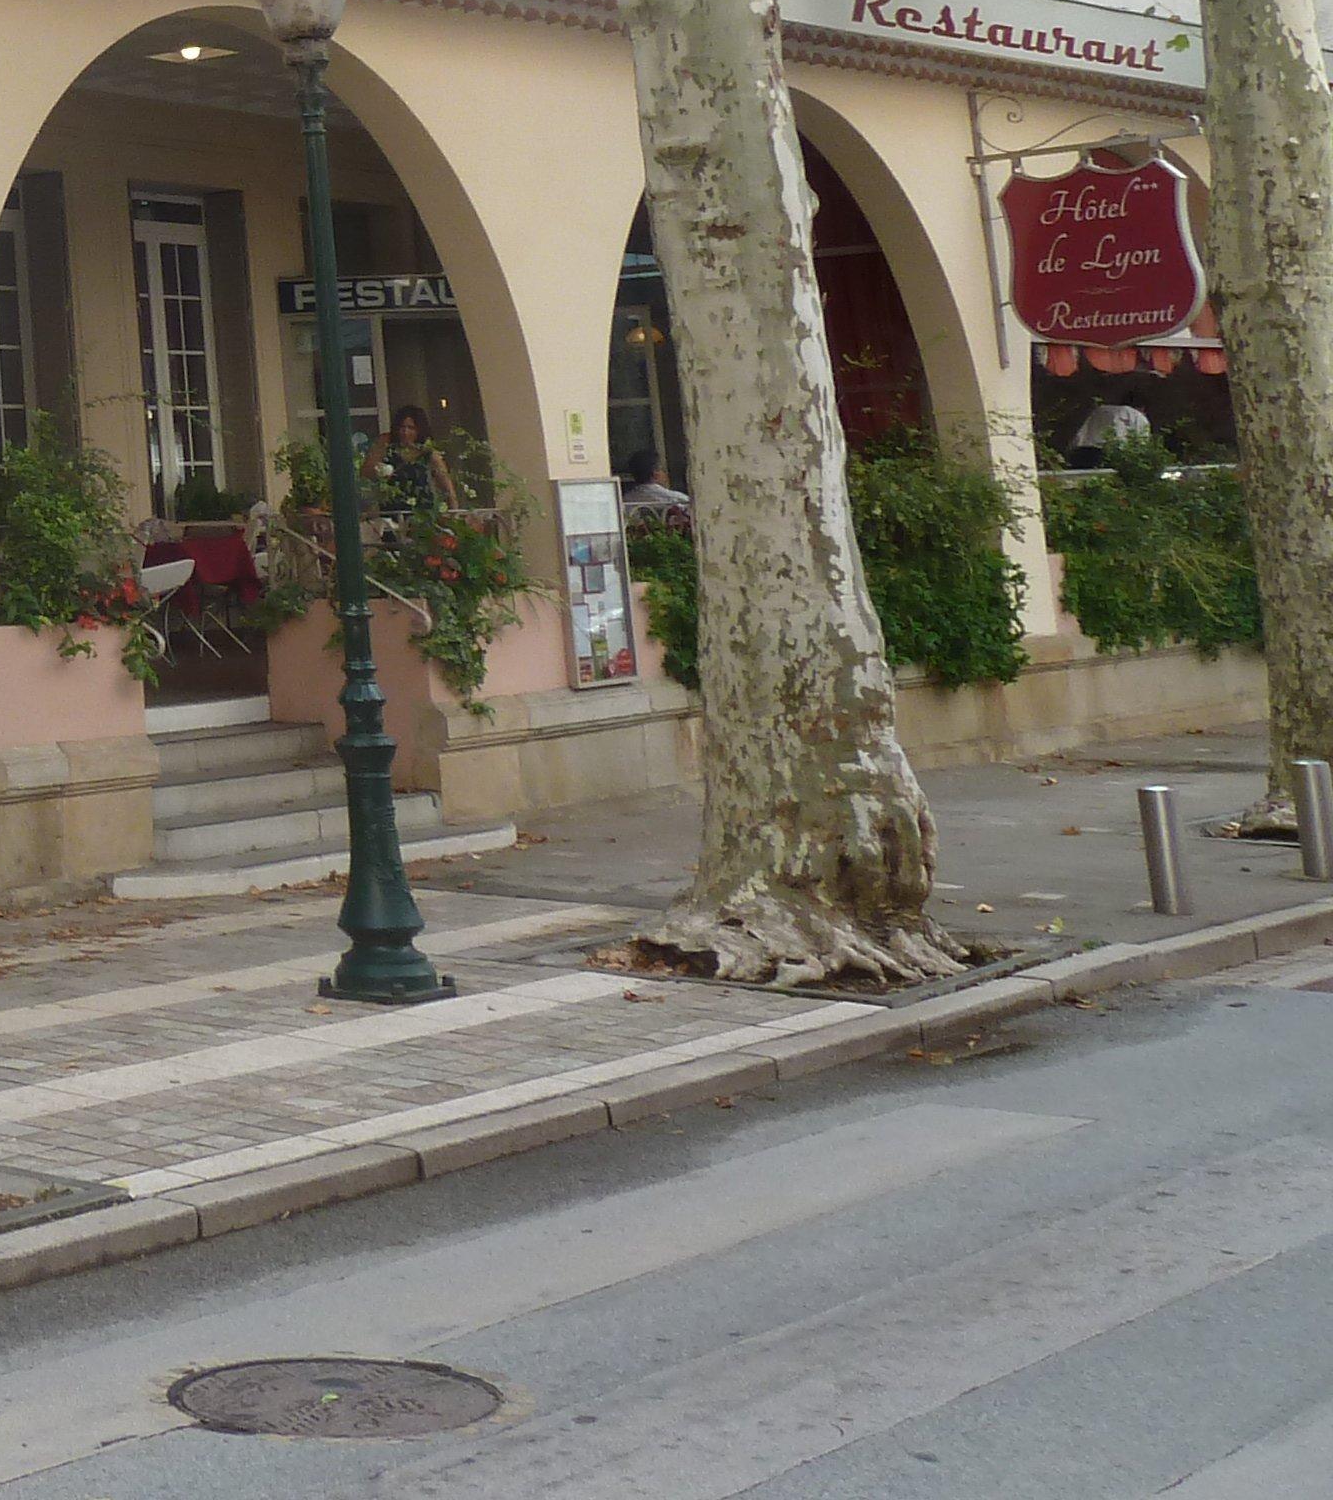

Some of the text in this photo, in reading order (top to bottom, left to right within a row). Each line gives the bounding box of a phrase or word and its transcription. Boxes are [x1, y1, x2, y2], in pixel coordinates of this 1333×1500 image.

[1039, 176, 1142, 226] Hôtel
[1037, 233, 1161, 280] de Lyon
[1036, 300, 1176, 332] Restaurant
